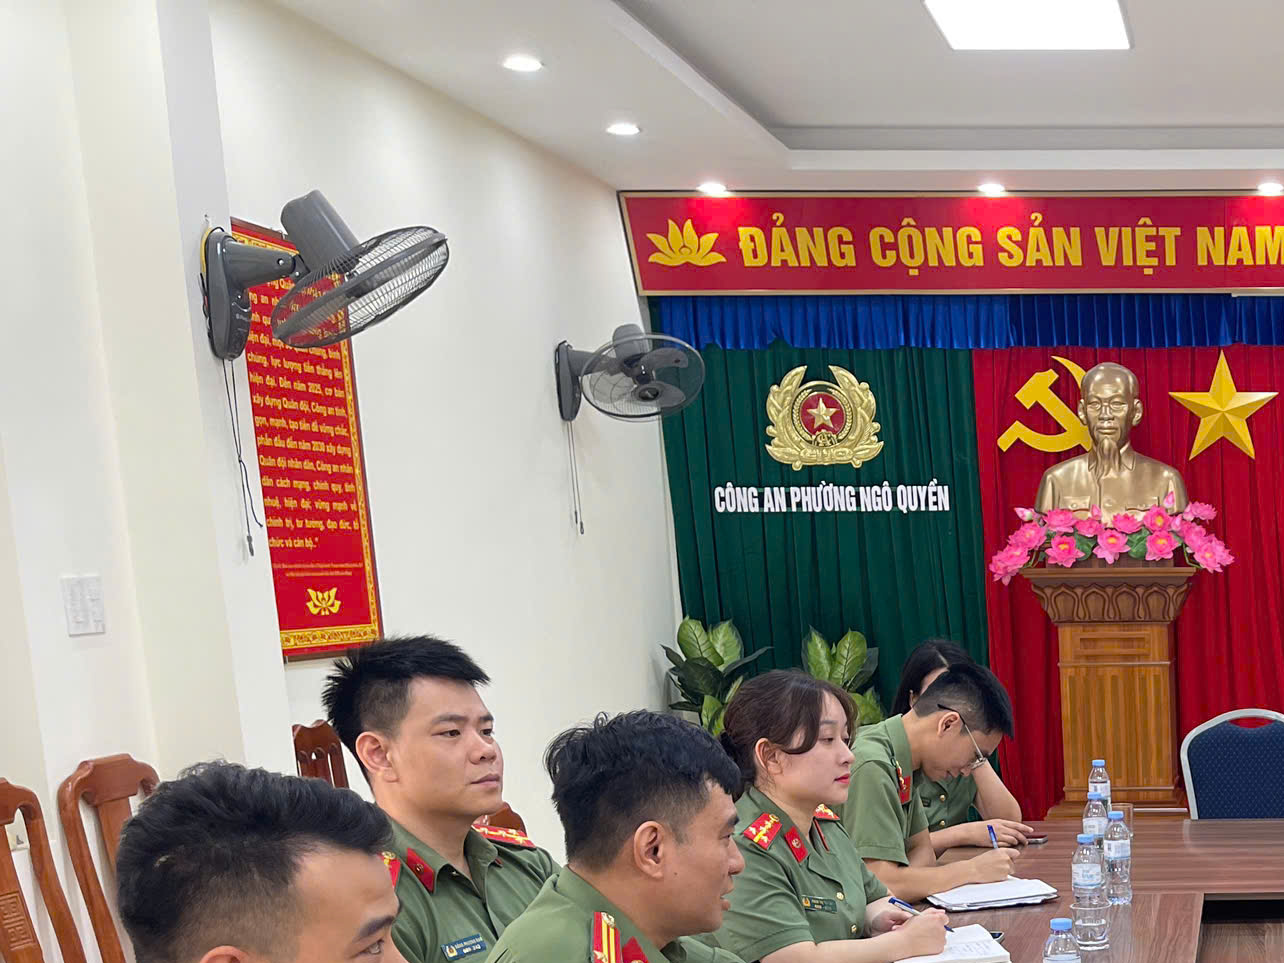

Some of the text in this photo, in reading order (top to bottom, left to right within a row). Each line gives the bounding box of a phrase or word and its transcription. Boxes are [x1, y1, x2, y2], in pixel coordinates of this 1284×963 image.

[738, 213, 856, 268] ĐẢNG
[870, 218, 984, 275] CỘNG
[998, 213, 1083, 268] SẢN
[1096, 217, 1181, 275] VIỆT
[714, 478, 950, 513] CÔNG AN PHƯỜNG NGÔ QUYỀN
